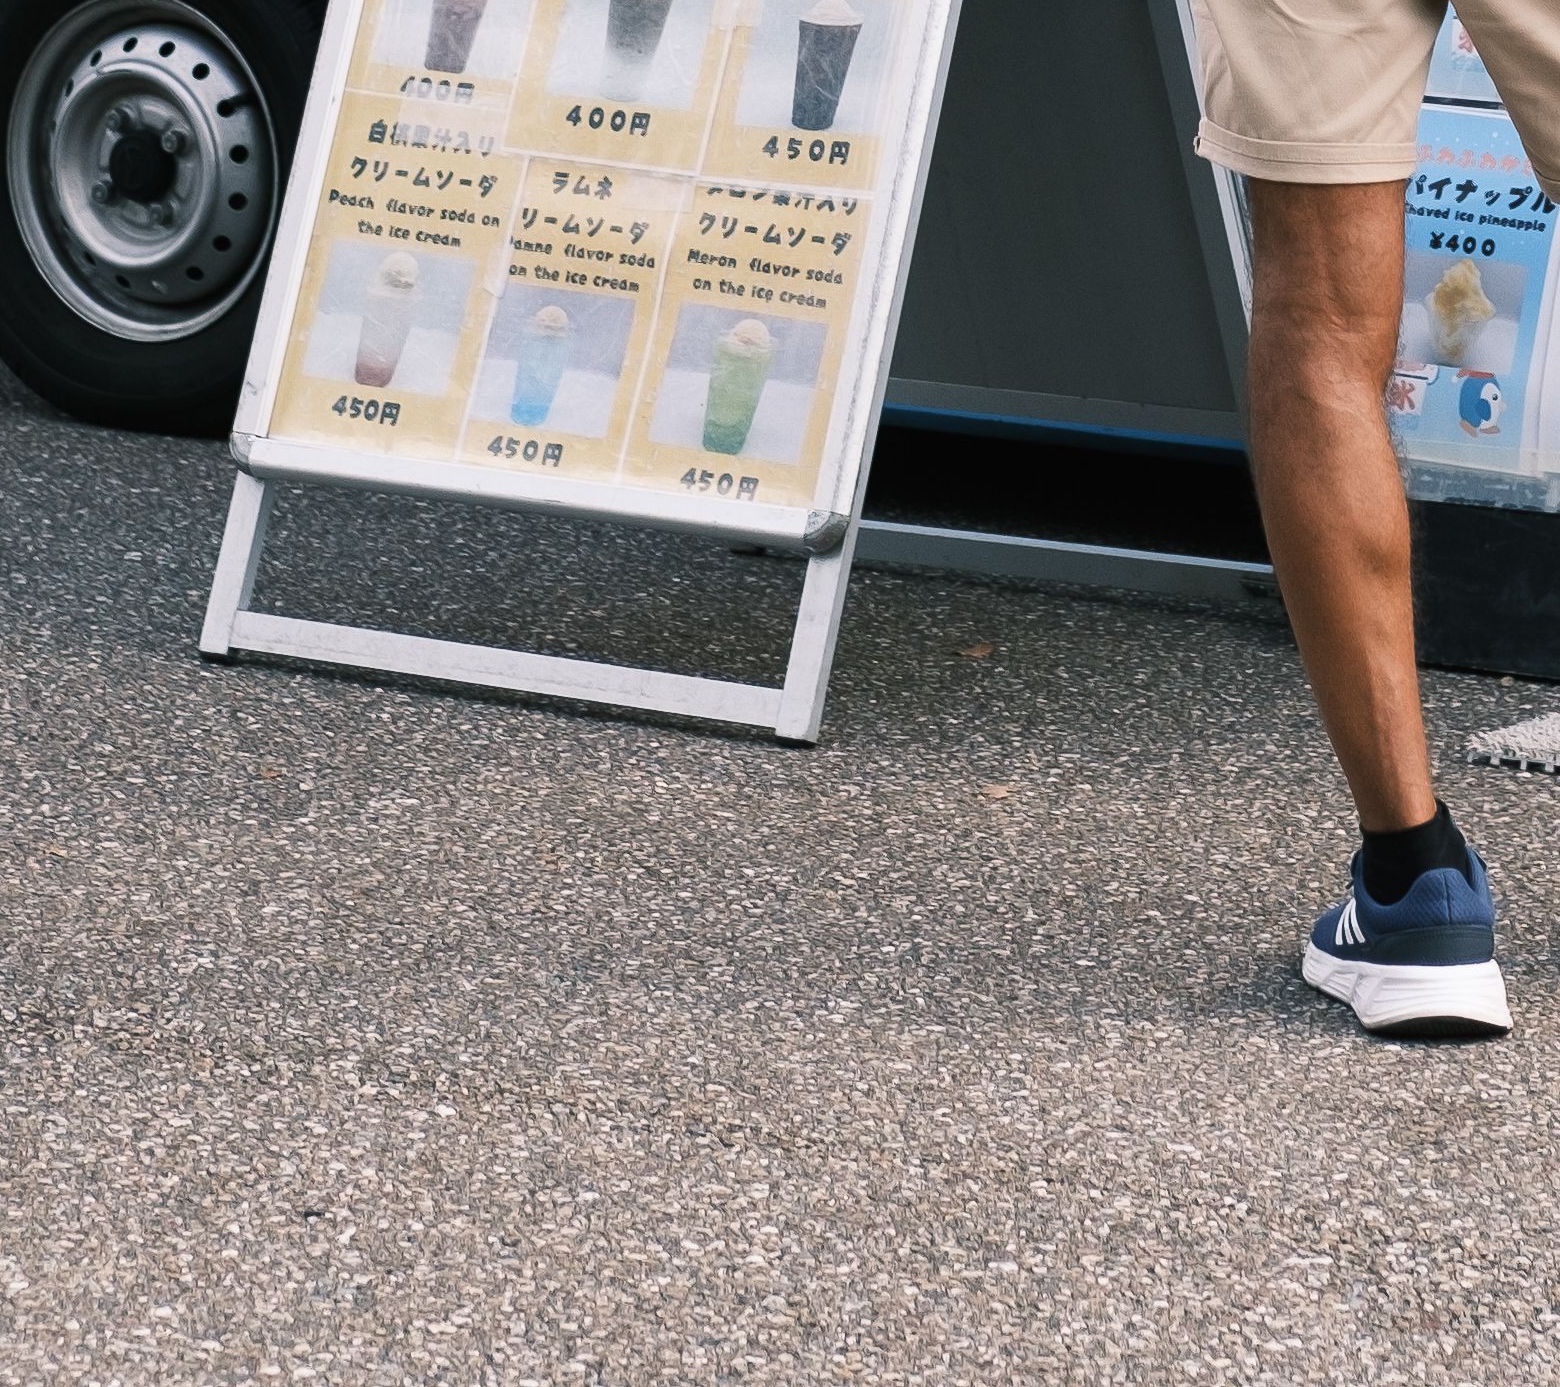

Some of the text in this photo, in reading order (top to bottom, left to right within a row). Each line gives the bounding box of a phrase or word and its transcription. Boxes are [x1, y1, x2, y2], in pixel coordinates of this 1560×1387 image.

[566, 106, 650, 136] 400円
[762, 135, 850, 166] 450円
[1429, 232, 1495, 256] ¥400
[332, 394, 400, 425] 450円
[487, 436, 562, 467] 450円
[680, 468, 759, 499] 450円
